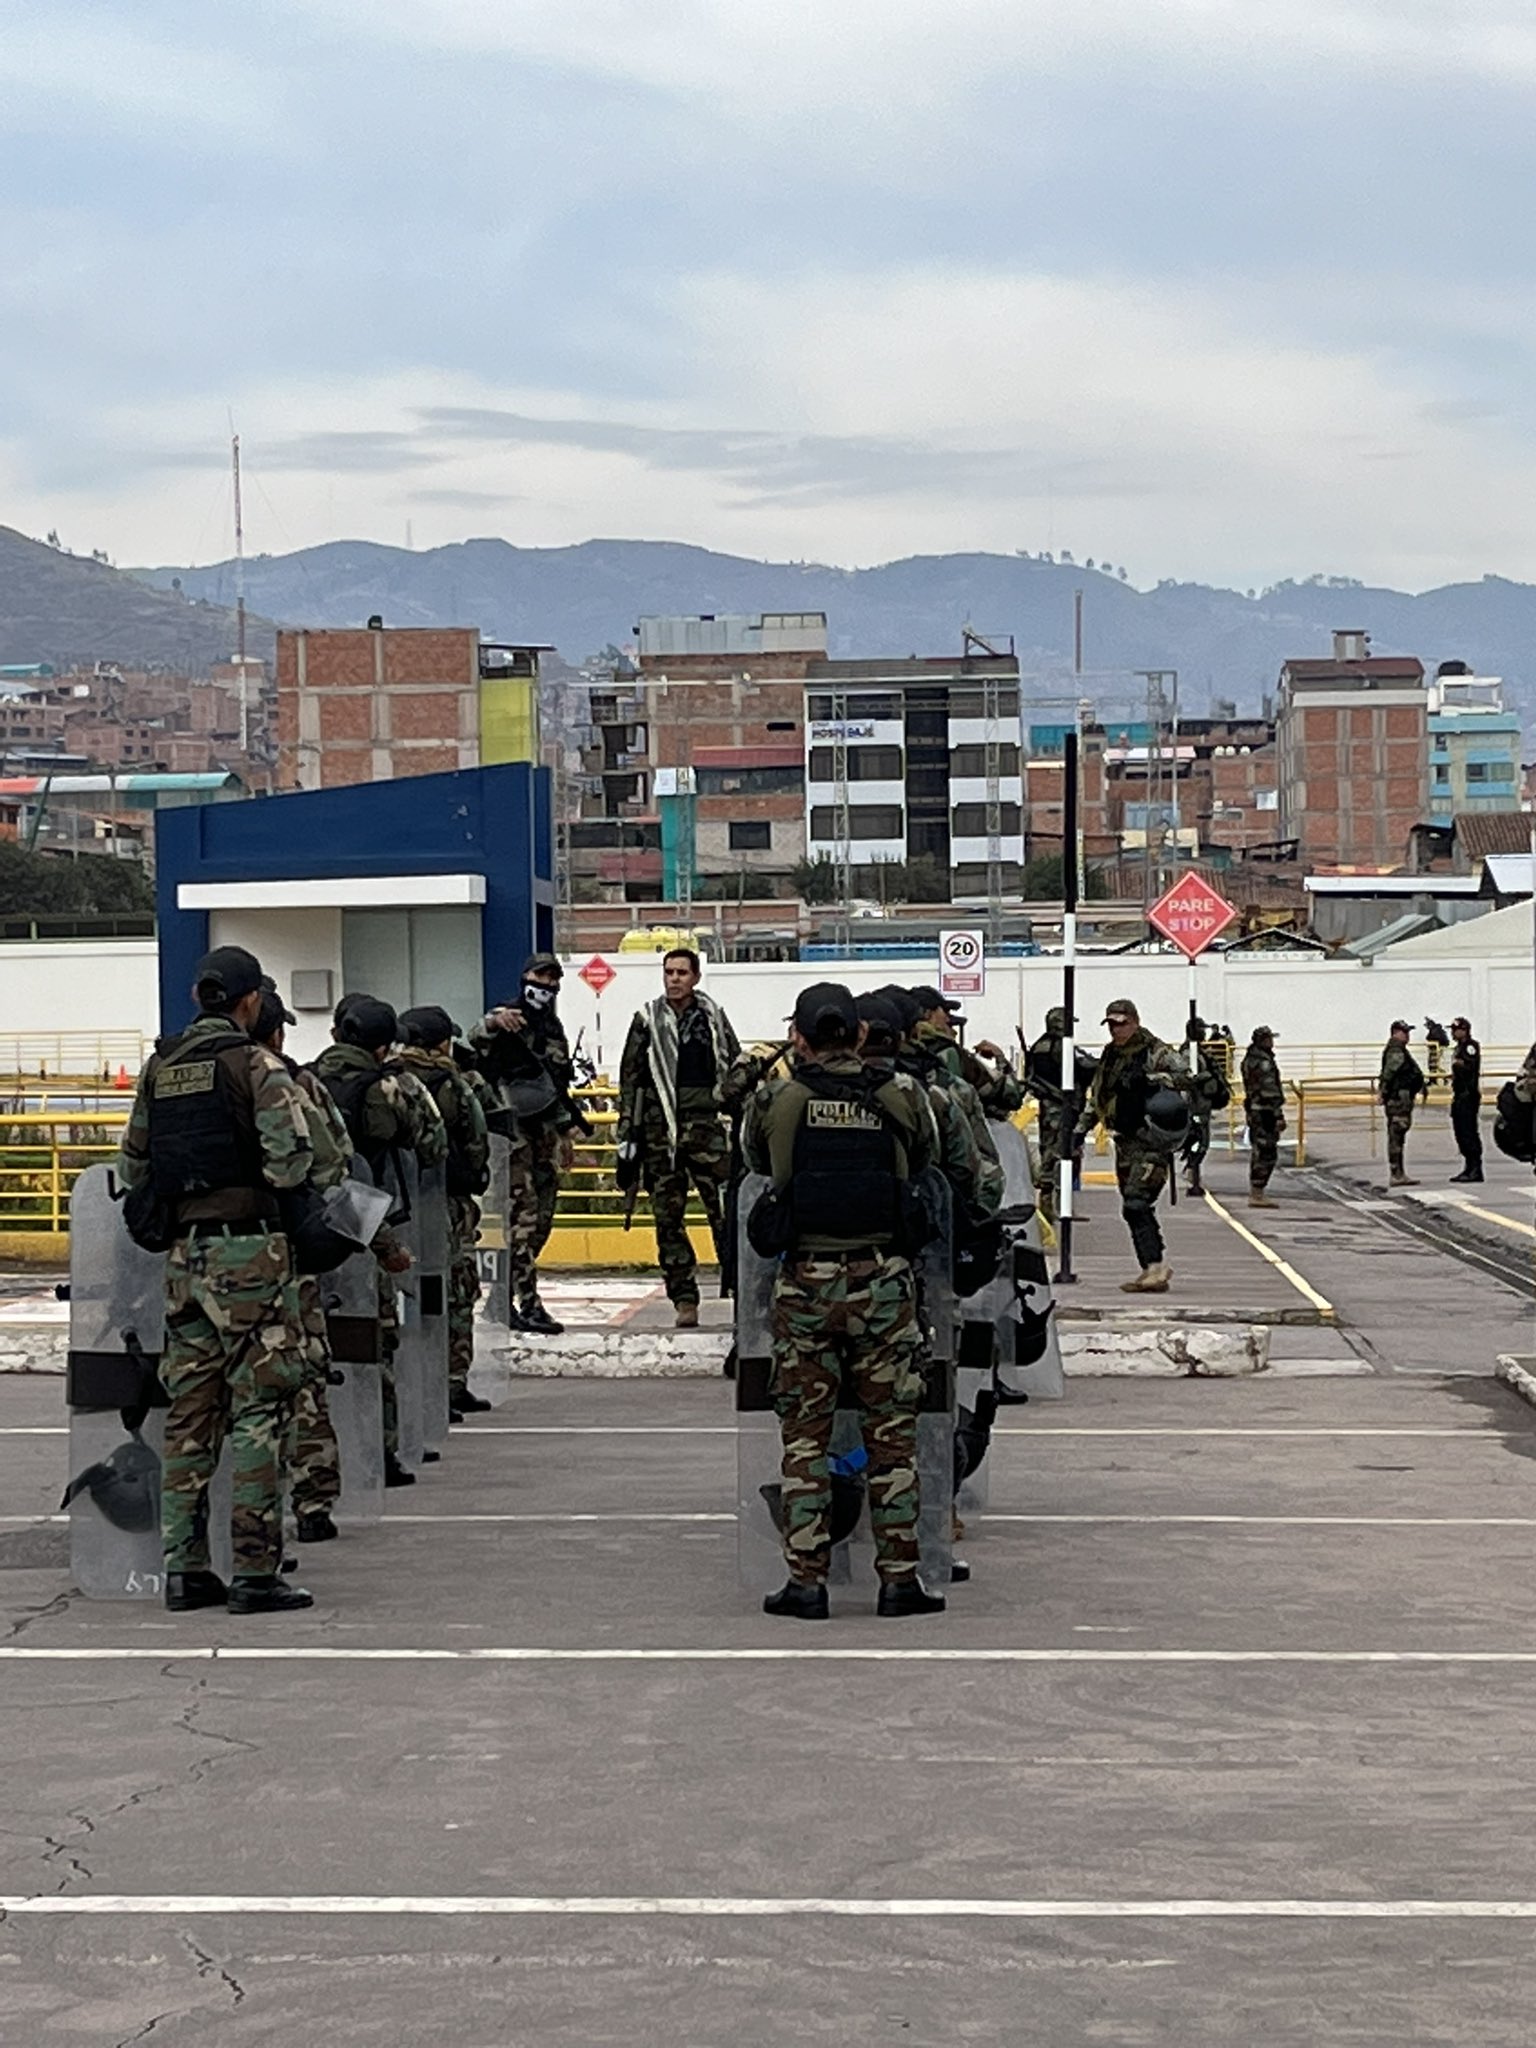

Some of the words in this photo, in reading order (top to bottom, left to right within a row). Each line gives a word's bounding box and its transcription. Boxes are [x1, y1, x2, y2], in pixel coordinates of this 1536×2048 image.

[1168, 899, 1215, 913] PARE
[1168, 917, 1216, 931] STOP
[950, 942, 974, 956] 20
